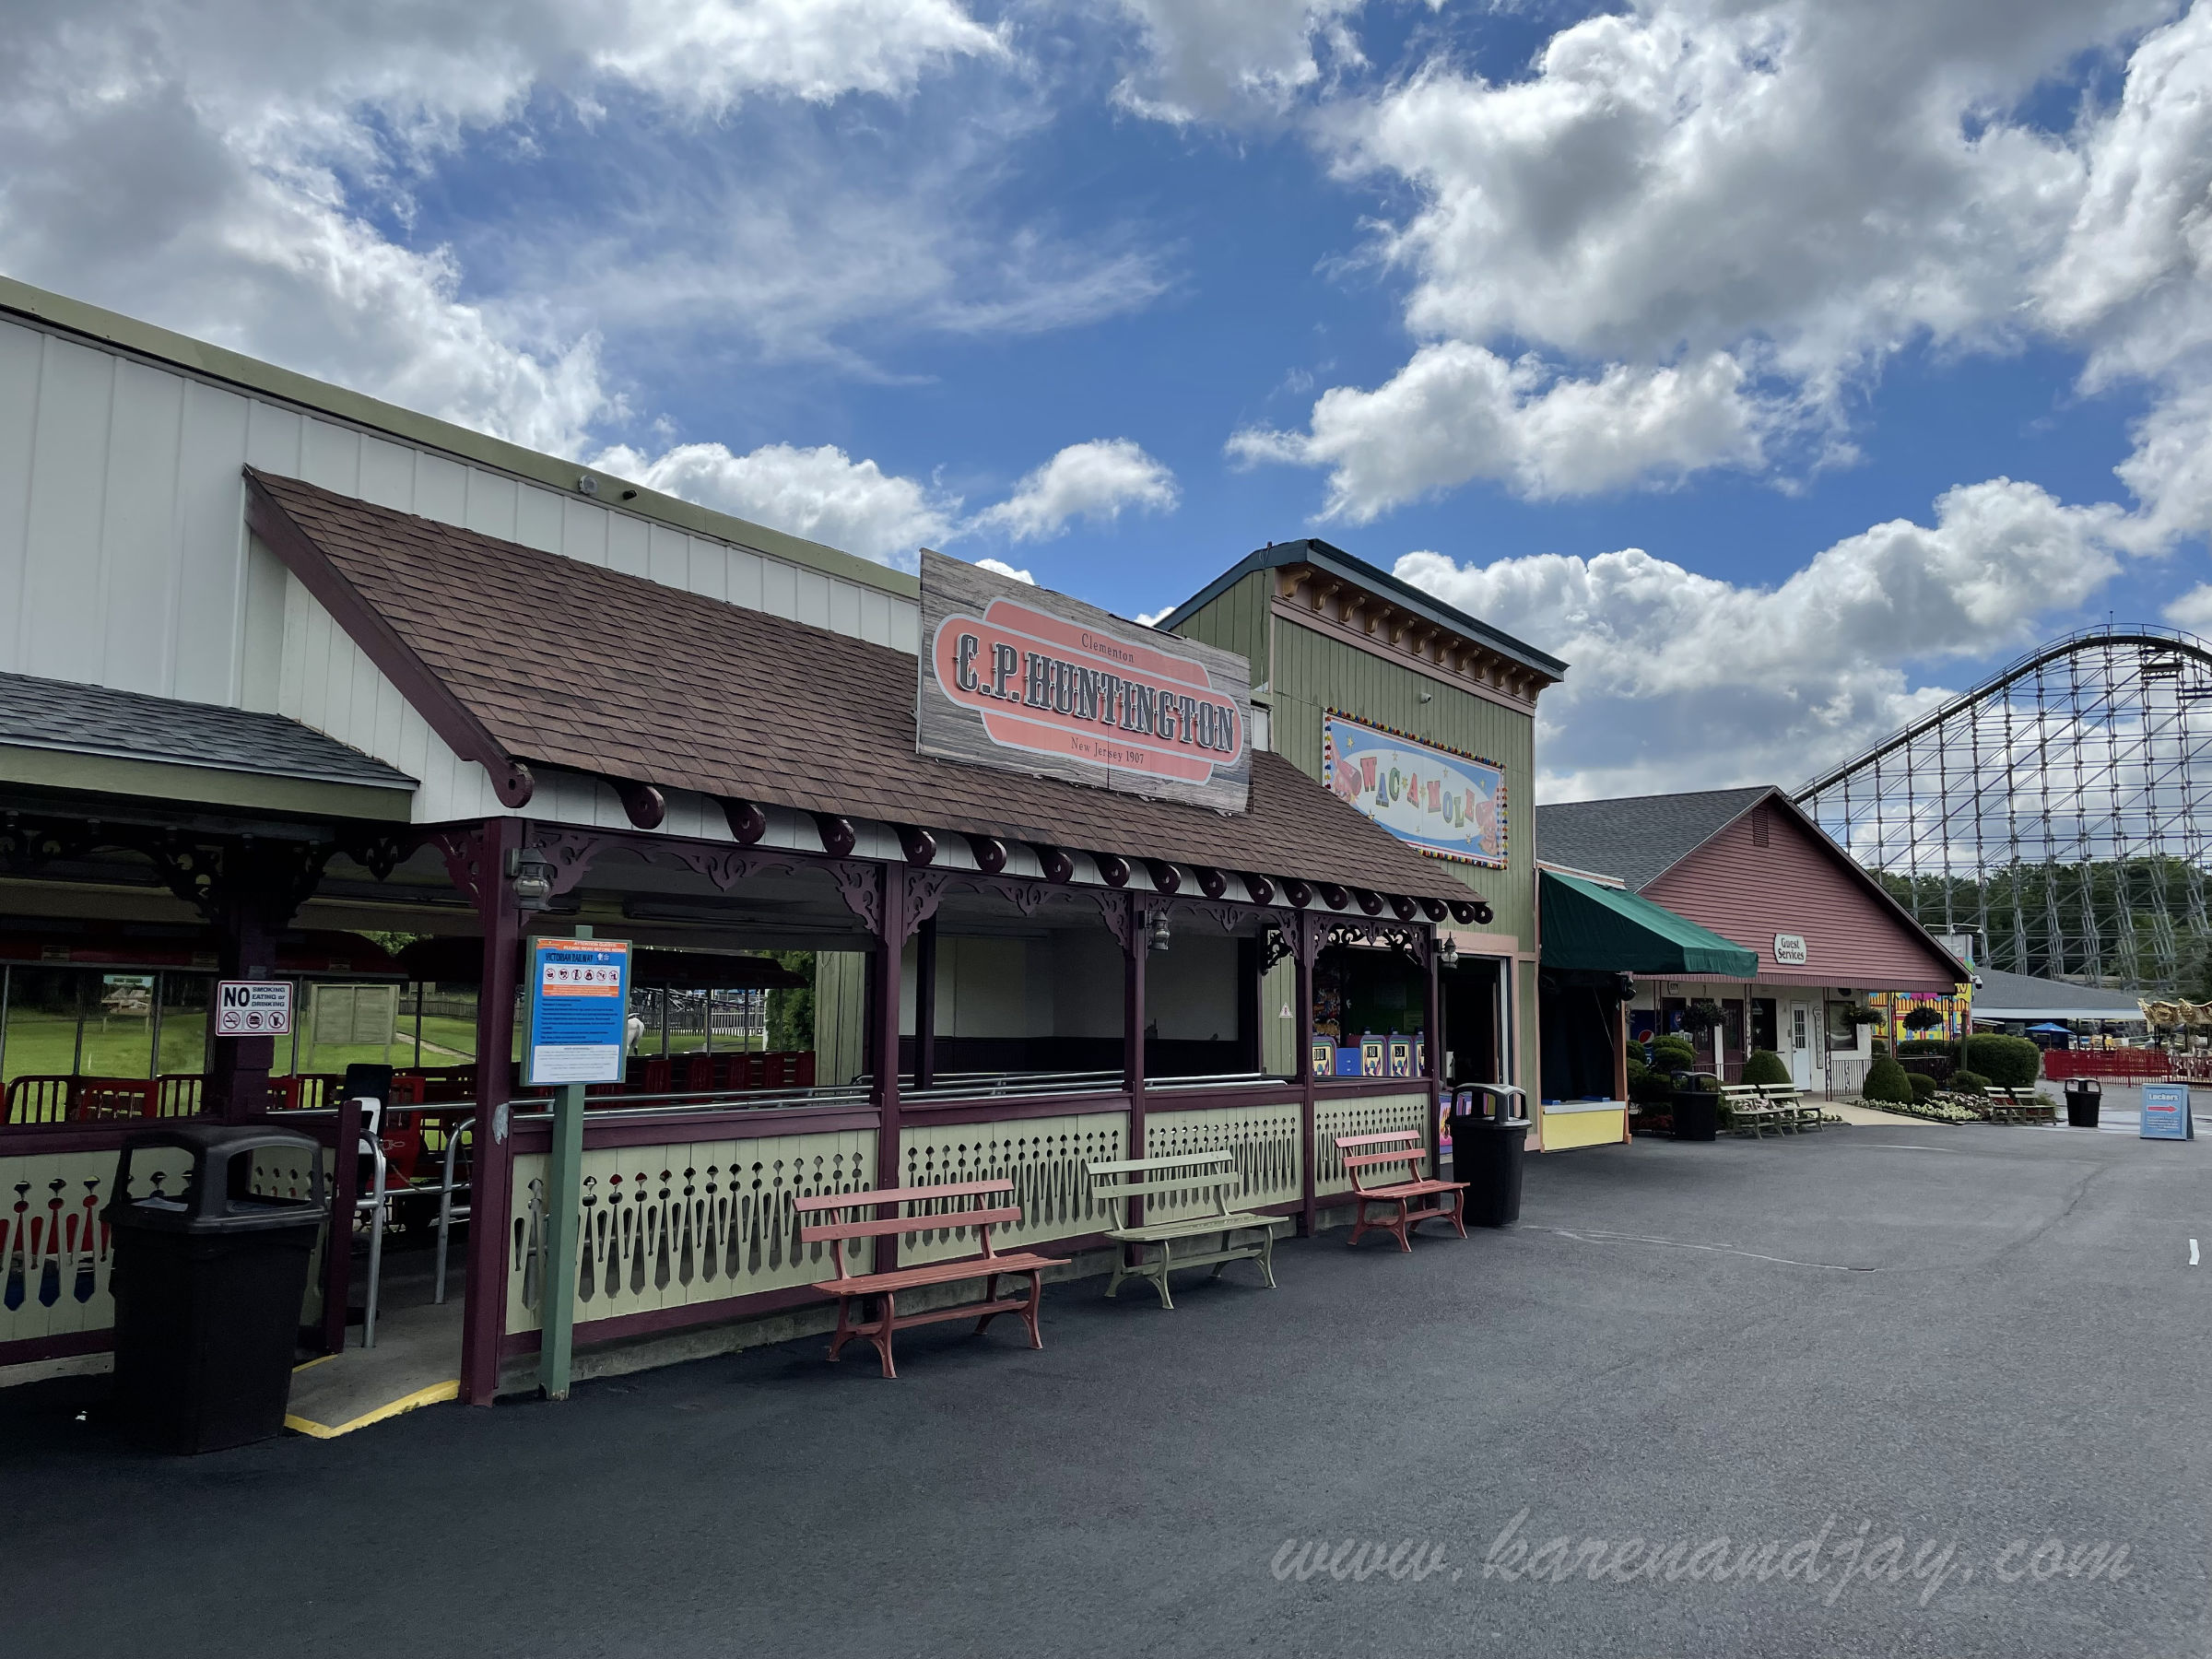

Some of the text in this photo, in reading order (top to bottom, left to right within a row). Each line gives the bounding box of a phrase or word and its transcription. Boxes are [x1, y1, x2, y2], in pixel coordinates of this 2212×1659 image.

[1081, 633, 1135, 663] Clementon
[1024, 651, 1236, 753] HUNTINGTON
[1071, 736, 1145, 764] New Jersey 1907
[1781, 938, 1799, 948] Guest
[546, 952, 571, 962] VICTORIAN
[572, 953, 594, 963] RAILWAY
[1778, 948, 1804, 959] Services
[224, 986, 251, 1007] NO
[2148, 1093, 2179, 1101] Lockers
